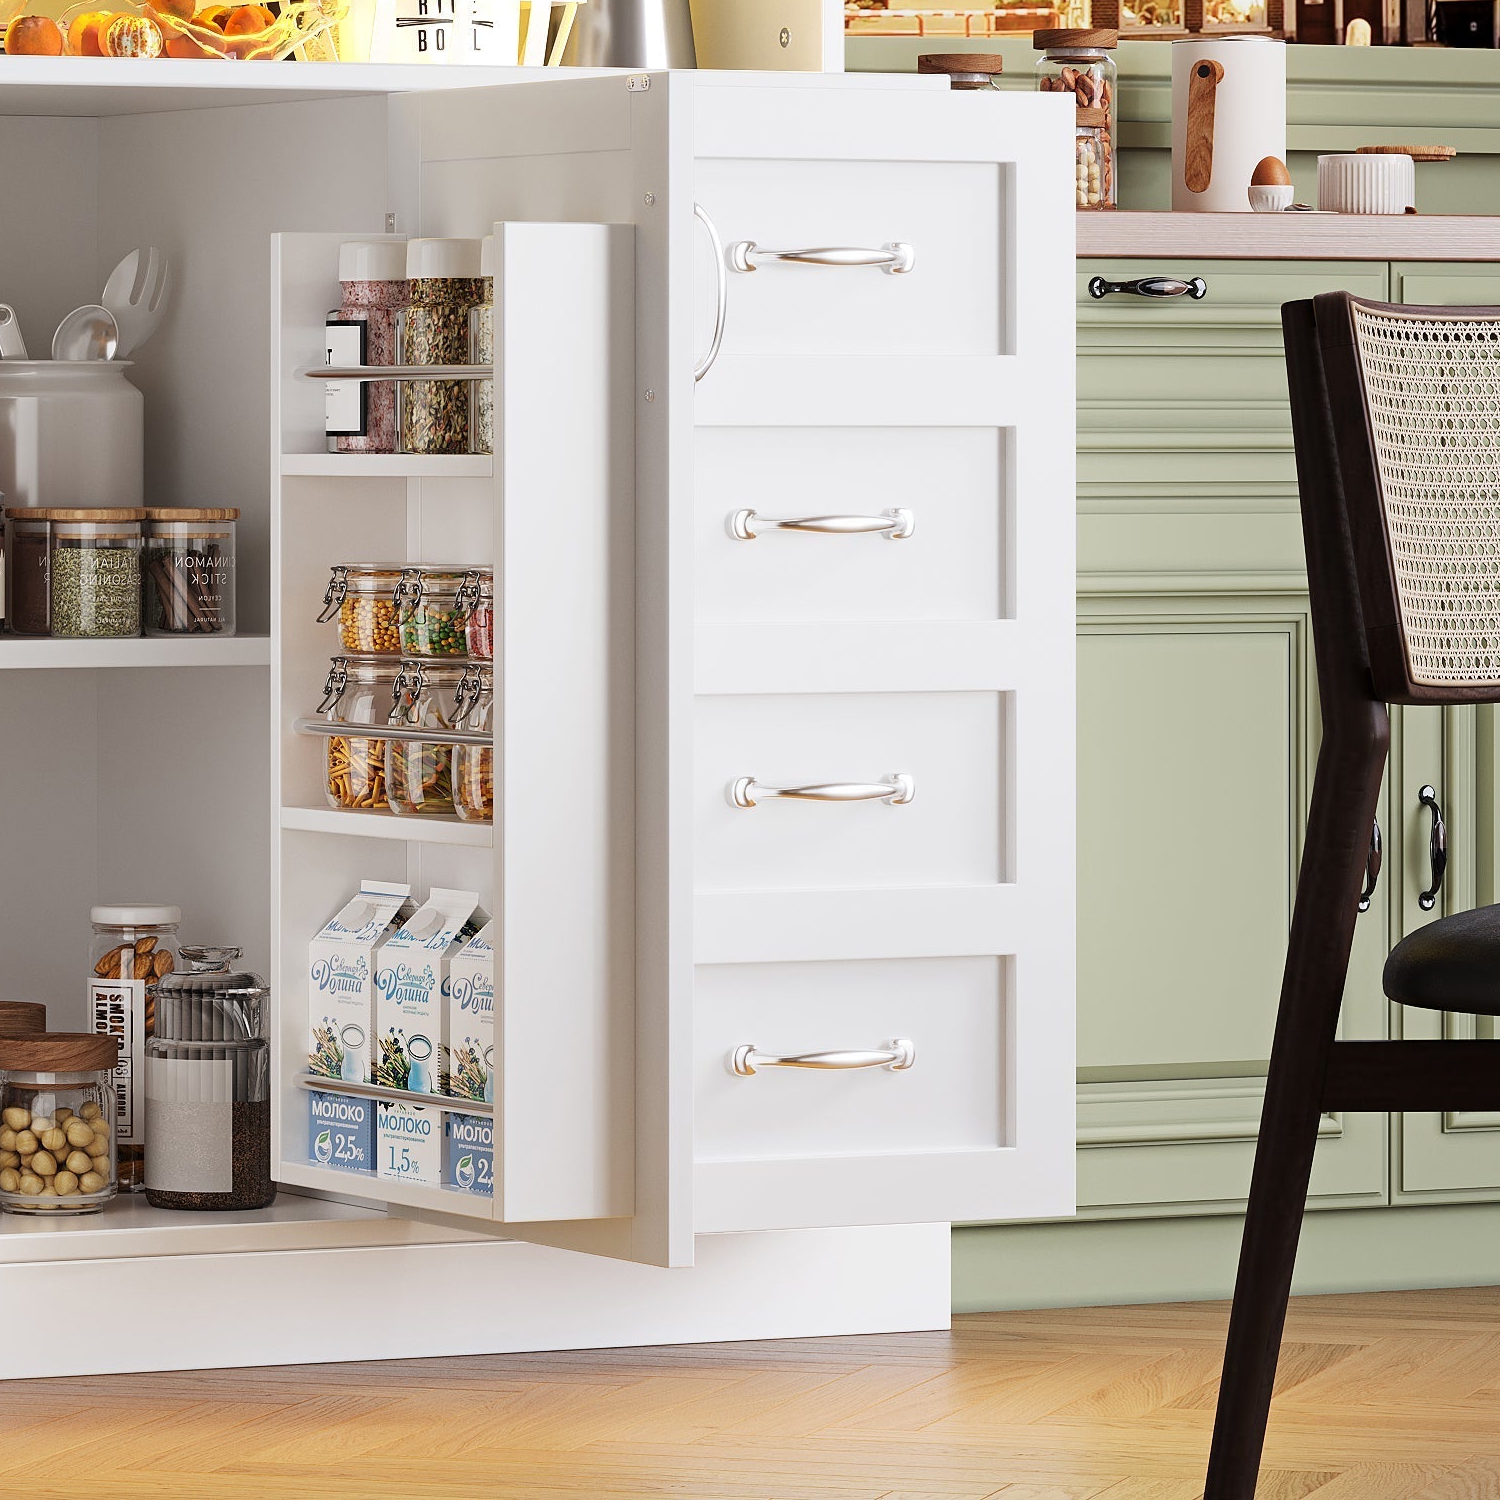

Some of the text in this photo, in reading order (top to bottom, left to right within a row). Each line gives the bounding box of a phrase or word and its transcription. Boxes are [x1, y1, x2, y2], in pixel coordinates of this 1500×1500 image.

[418, 29, 481, 52] BOL
[116, 1060, 128, 1076] 03
[312, 1100, 365, 1123] МОЛОКО
[378, 1114, 431, 1136] МОЛОКО
[453, 1123, 493, 1145] МОЛО
[334, 1133, 365, 1162] 2,5%
[389, 1146, 420, 1174] 1,5%
